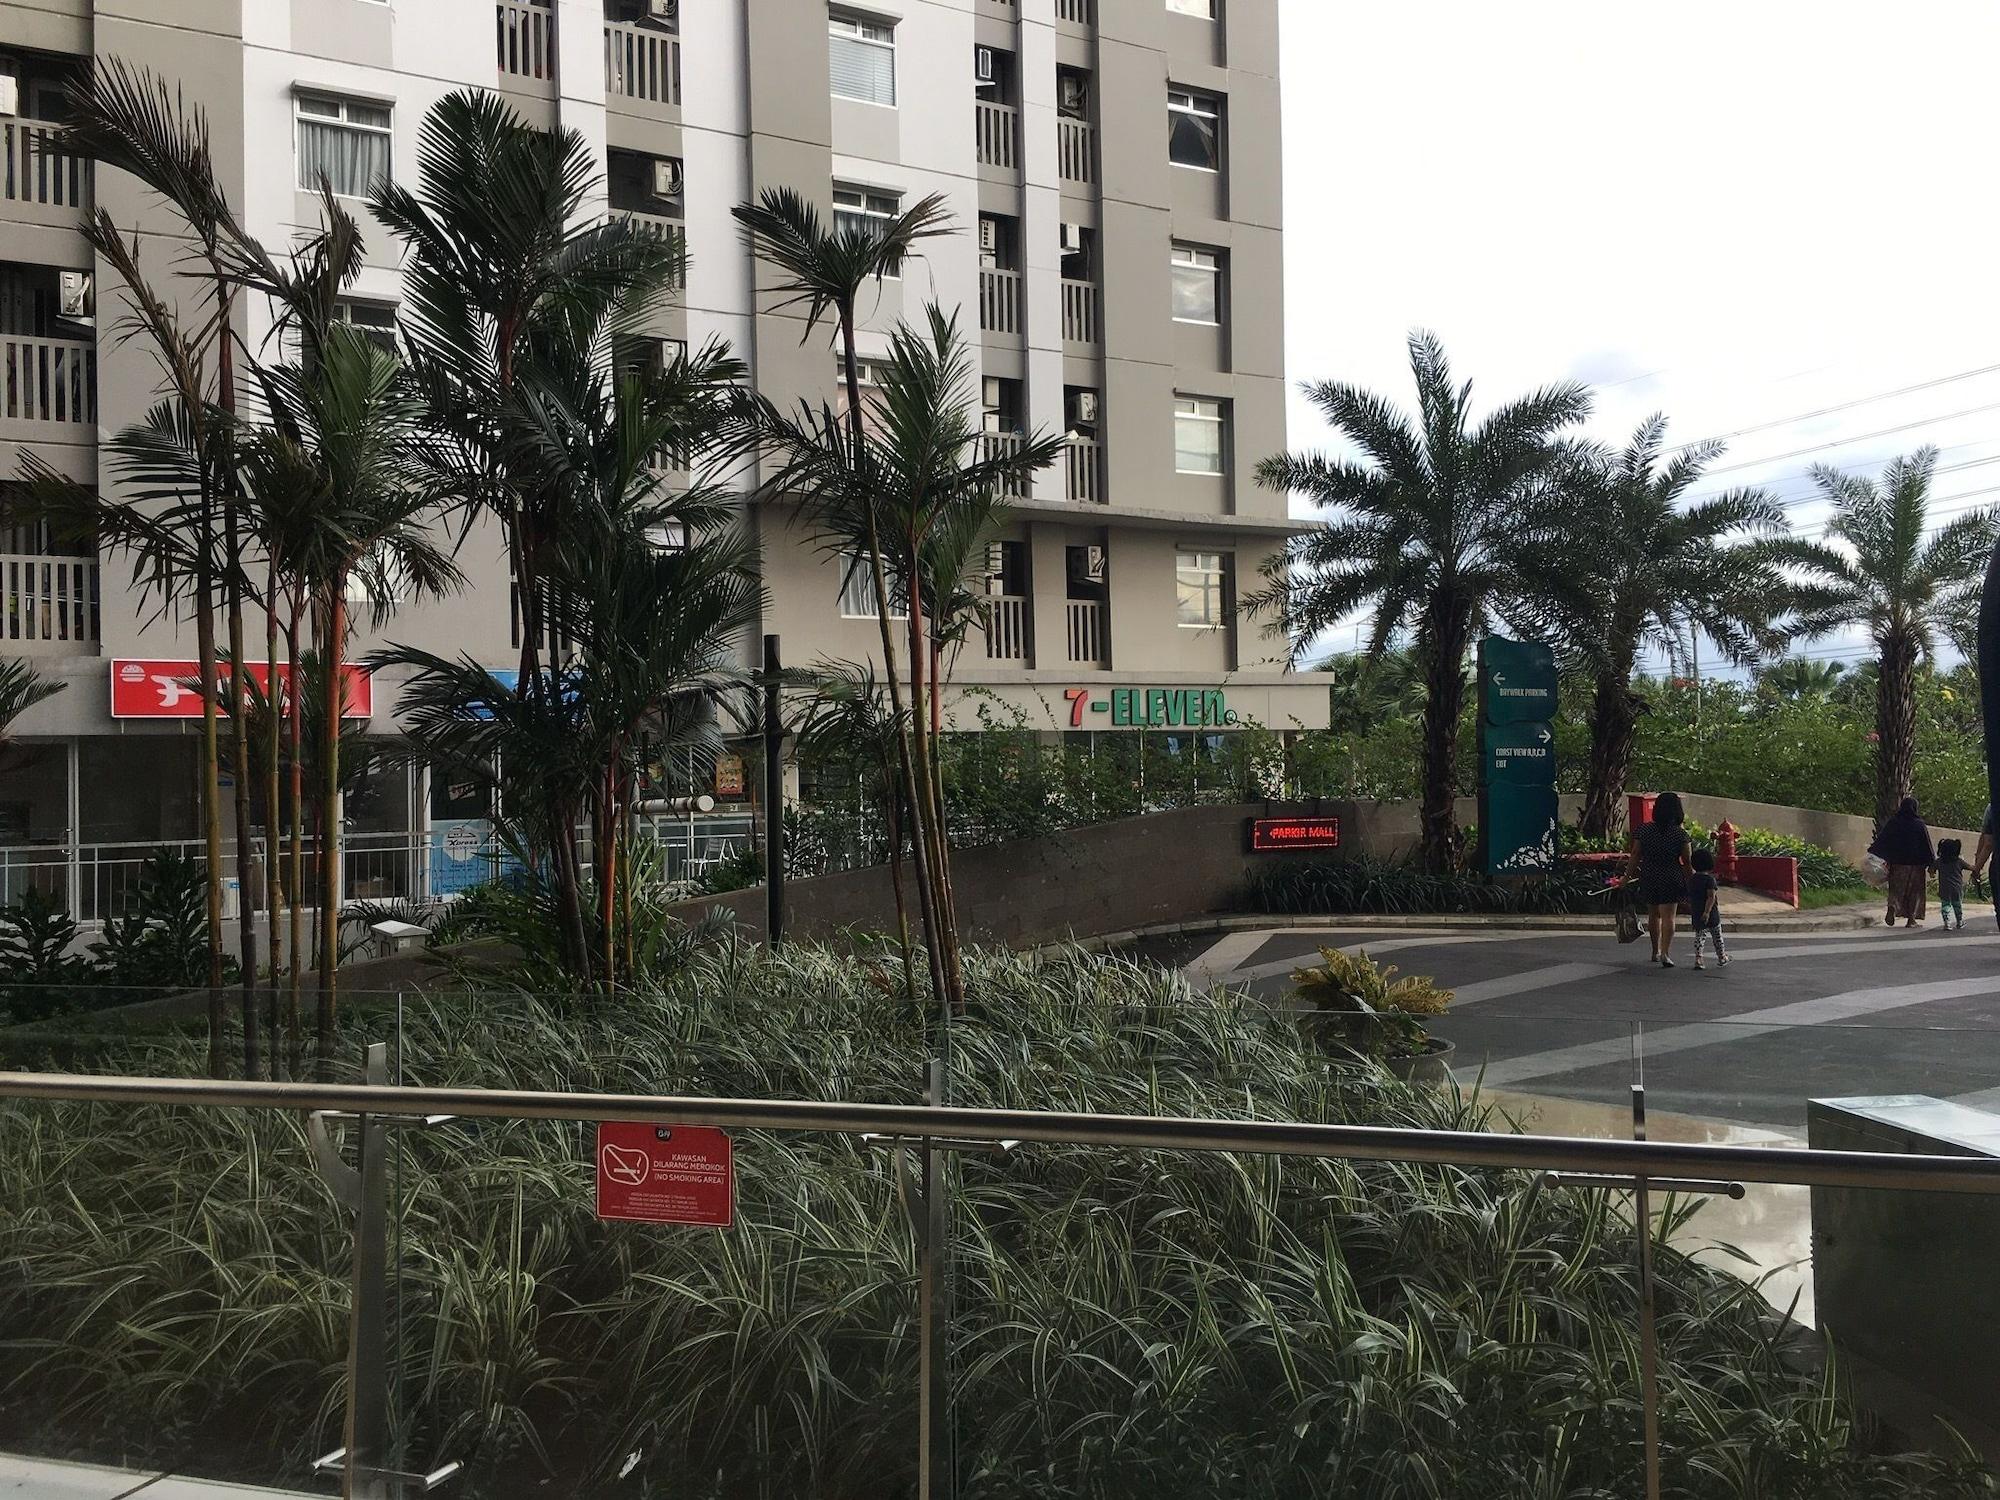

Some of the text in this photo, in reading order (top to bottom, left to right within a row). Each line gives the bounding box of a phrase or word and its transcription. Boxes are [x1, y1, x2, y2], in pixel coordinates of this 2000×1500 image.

[1525, 688, 1548, 697] PARKING
[1496, 748, 1512, 757] COAST
[1513, 748, 1527, 757] VIEW
[1496, 760, 1507, 768] EXIT
[1308, 826, 1335, 838] MALL
[671, 1154, 707, 1162] KAWASAN
[653, 1160, 726, 1172] DILARANG MEROKOK
[654, 1173, 724, 1184] (NO SMOKING AREA)
